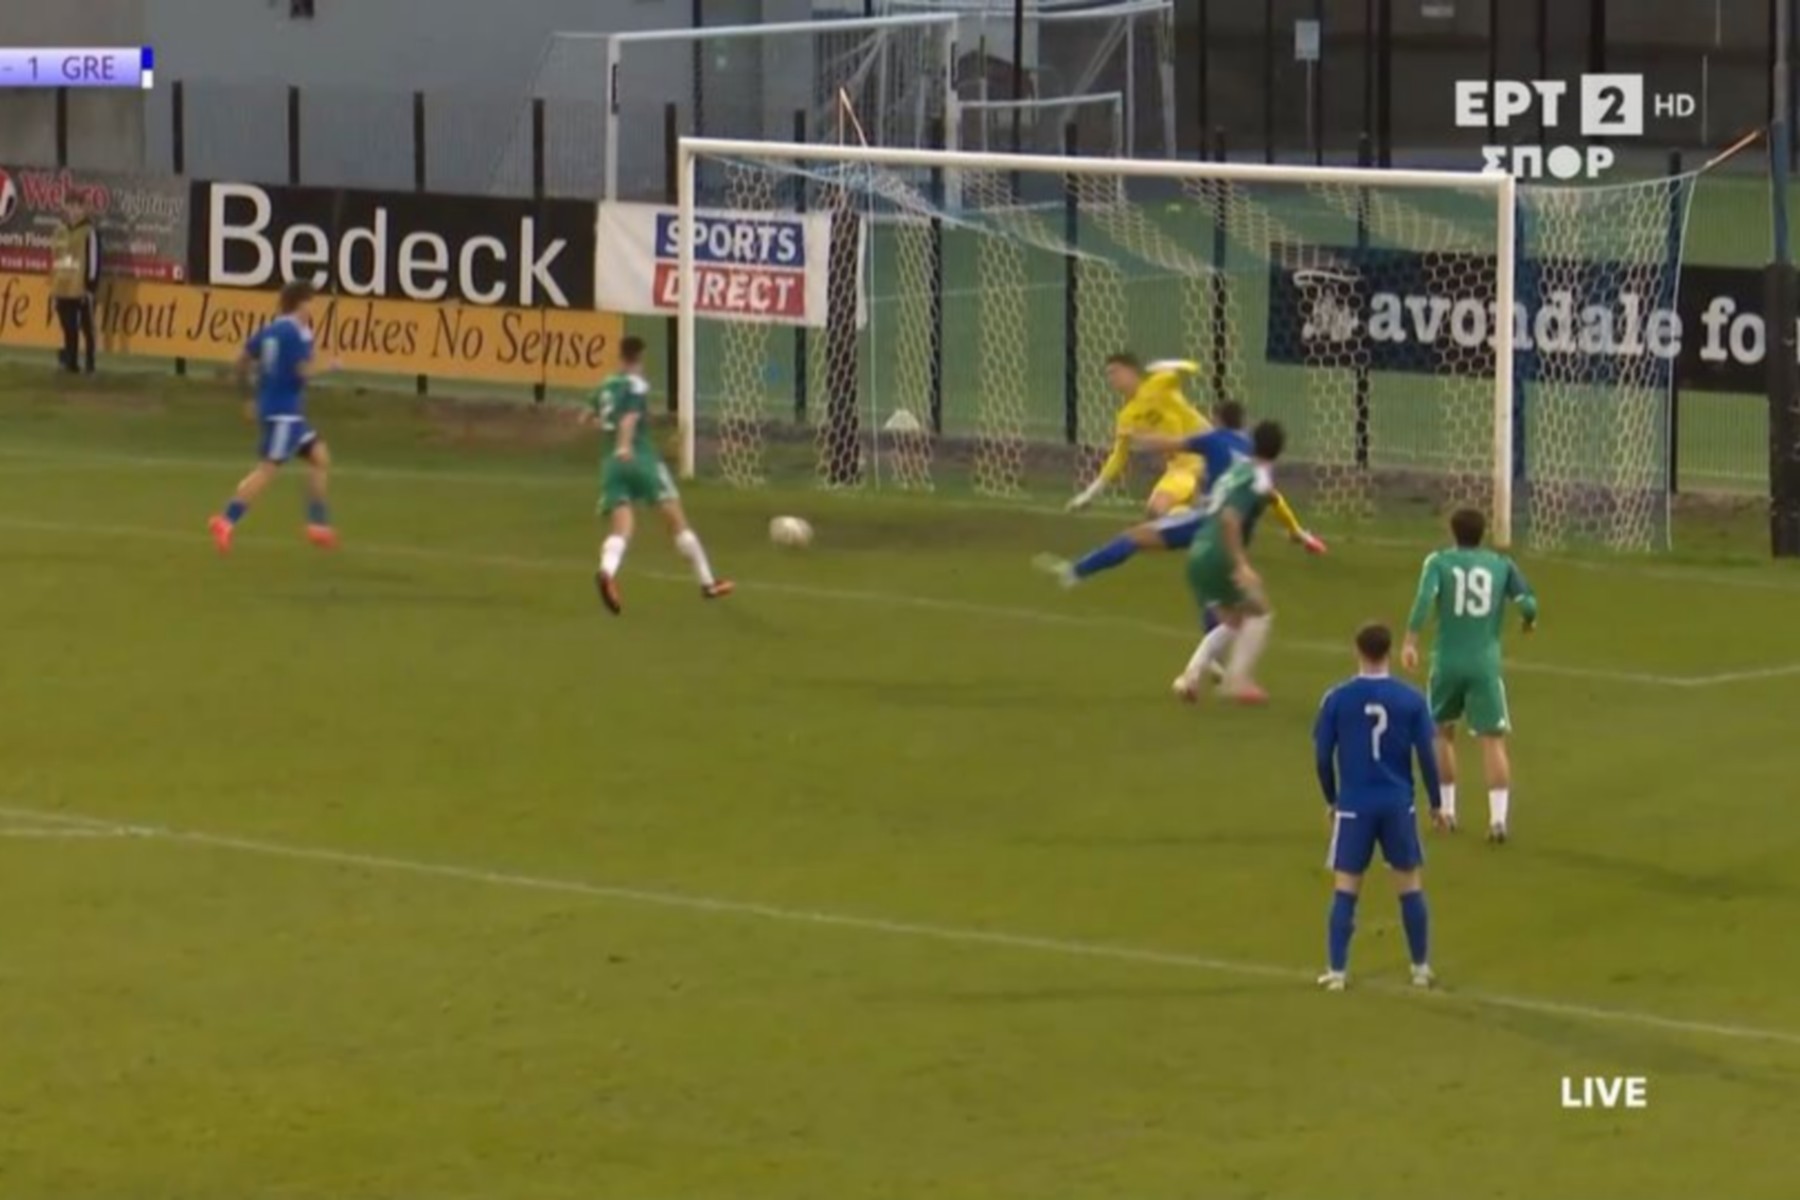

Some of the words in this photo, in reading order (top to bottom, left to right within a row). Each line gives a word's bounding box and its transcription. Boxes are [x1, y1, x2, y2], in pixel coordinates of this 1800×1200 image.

[209, 182, 570, 308] Bedeck
[664, 220, 797, 262] SPORTS
[187, 291, 276, 345] Jesu
[308, 300, 419, 356] Makes
[432, 307, 484, 361] No
[496, 309, 606, 369] Sense
[1367, 289, 1683, 358] avondale
[1452, 566, 1492, 616] 19
[1364, 703, 1388, 760] 7
